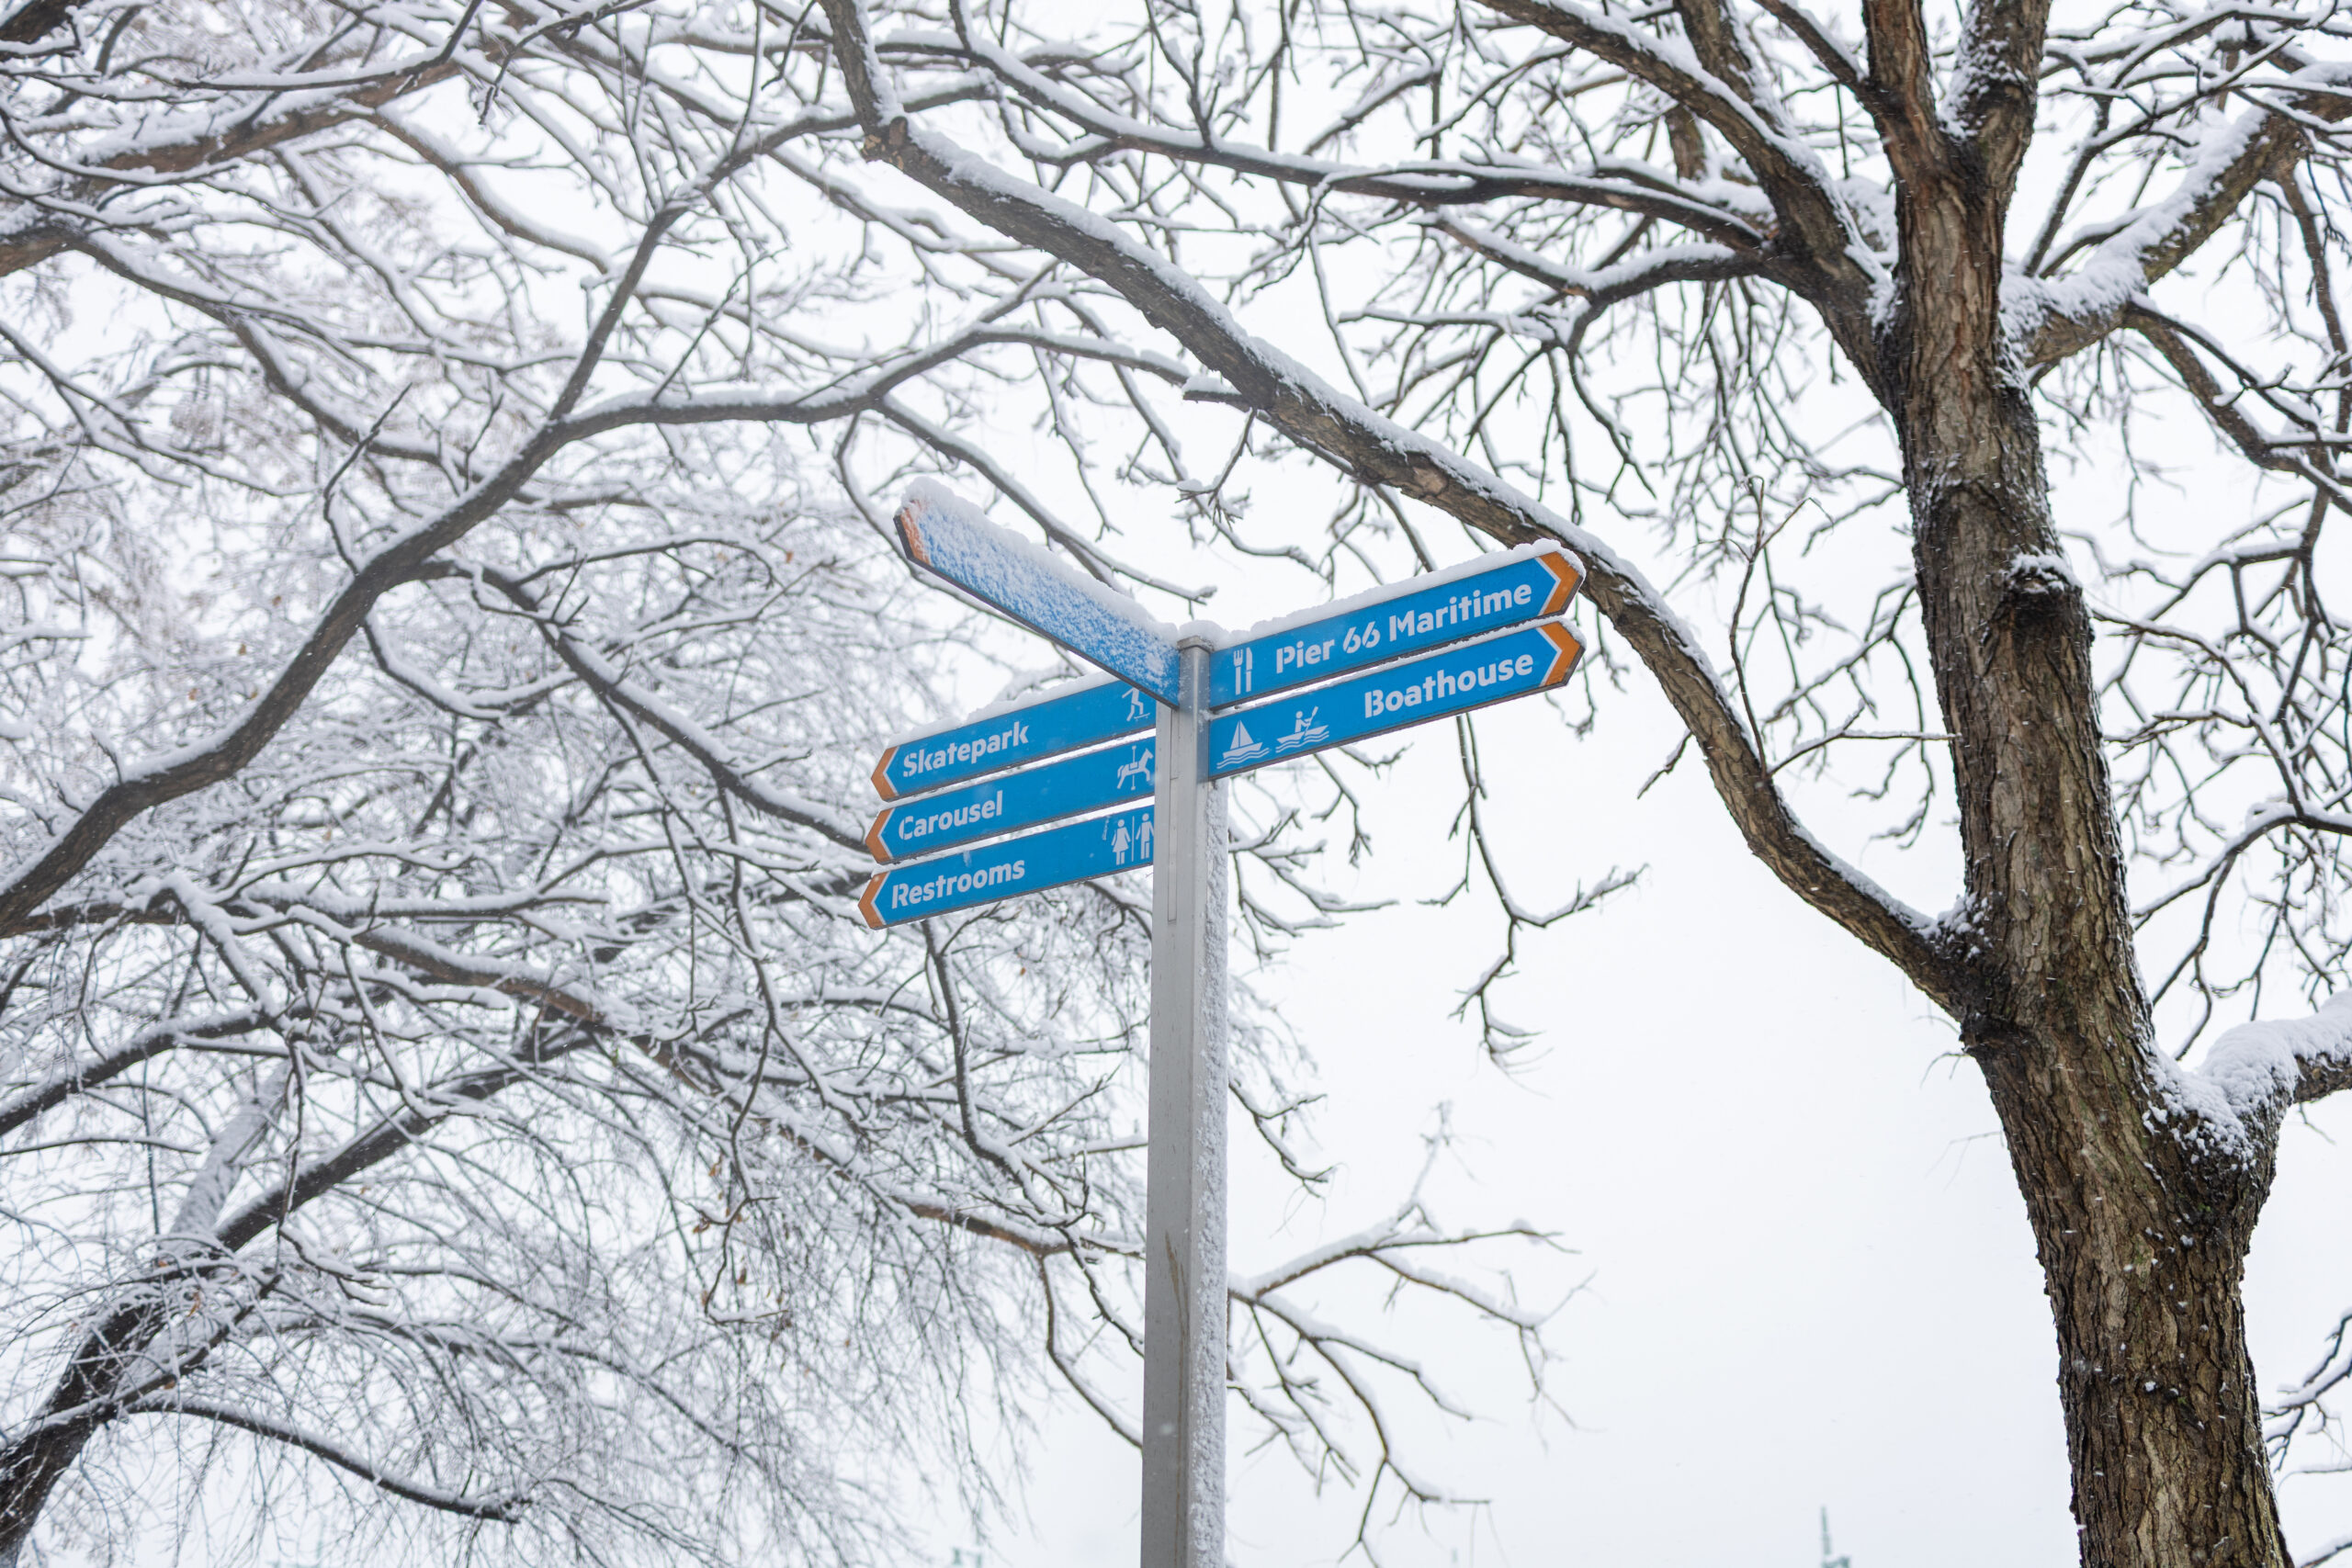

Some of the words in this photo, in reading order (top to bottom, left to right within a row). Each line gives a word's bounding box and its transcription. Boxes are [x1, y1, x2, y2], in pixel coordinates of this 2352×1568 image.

[1275, 640, 1336, 674] Pier
[1342, 621, 1380, 653] 66
[1388, 583, 1532, 641] Maritime
[1364, 653, 1534, 718] Boathouse
[903, 721, 1030, 777] Skatepark
[898, 790, 1003, 840] Carousel
[891, 859, 1025, 909] Restrooms
